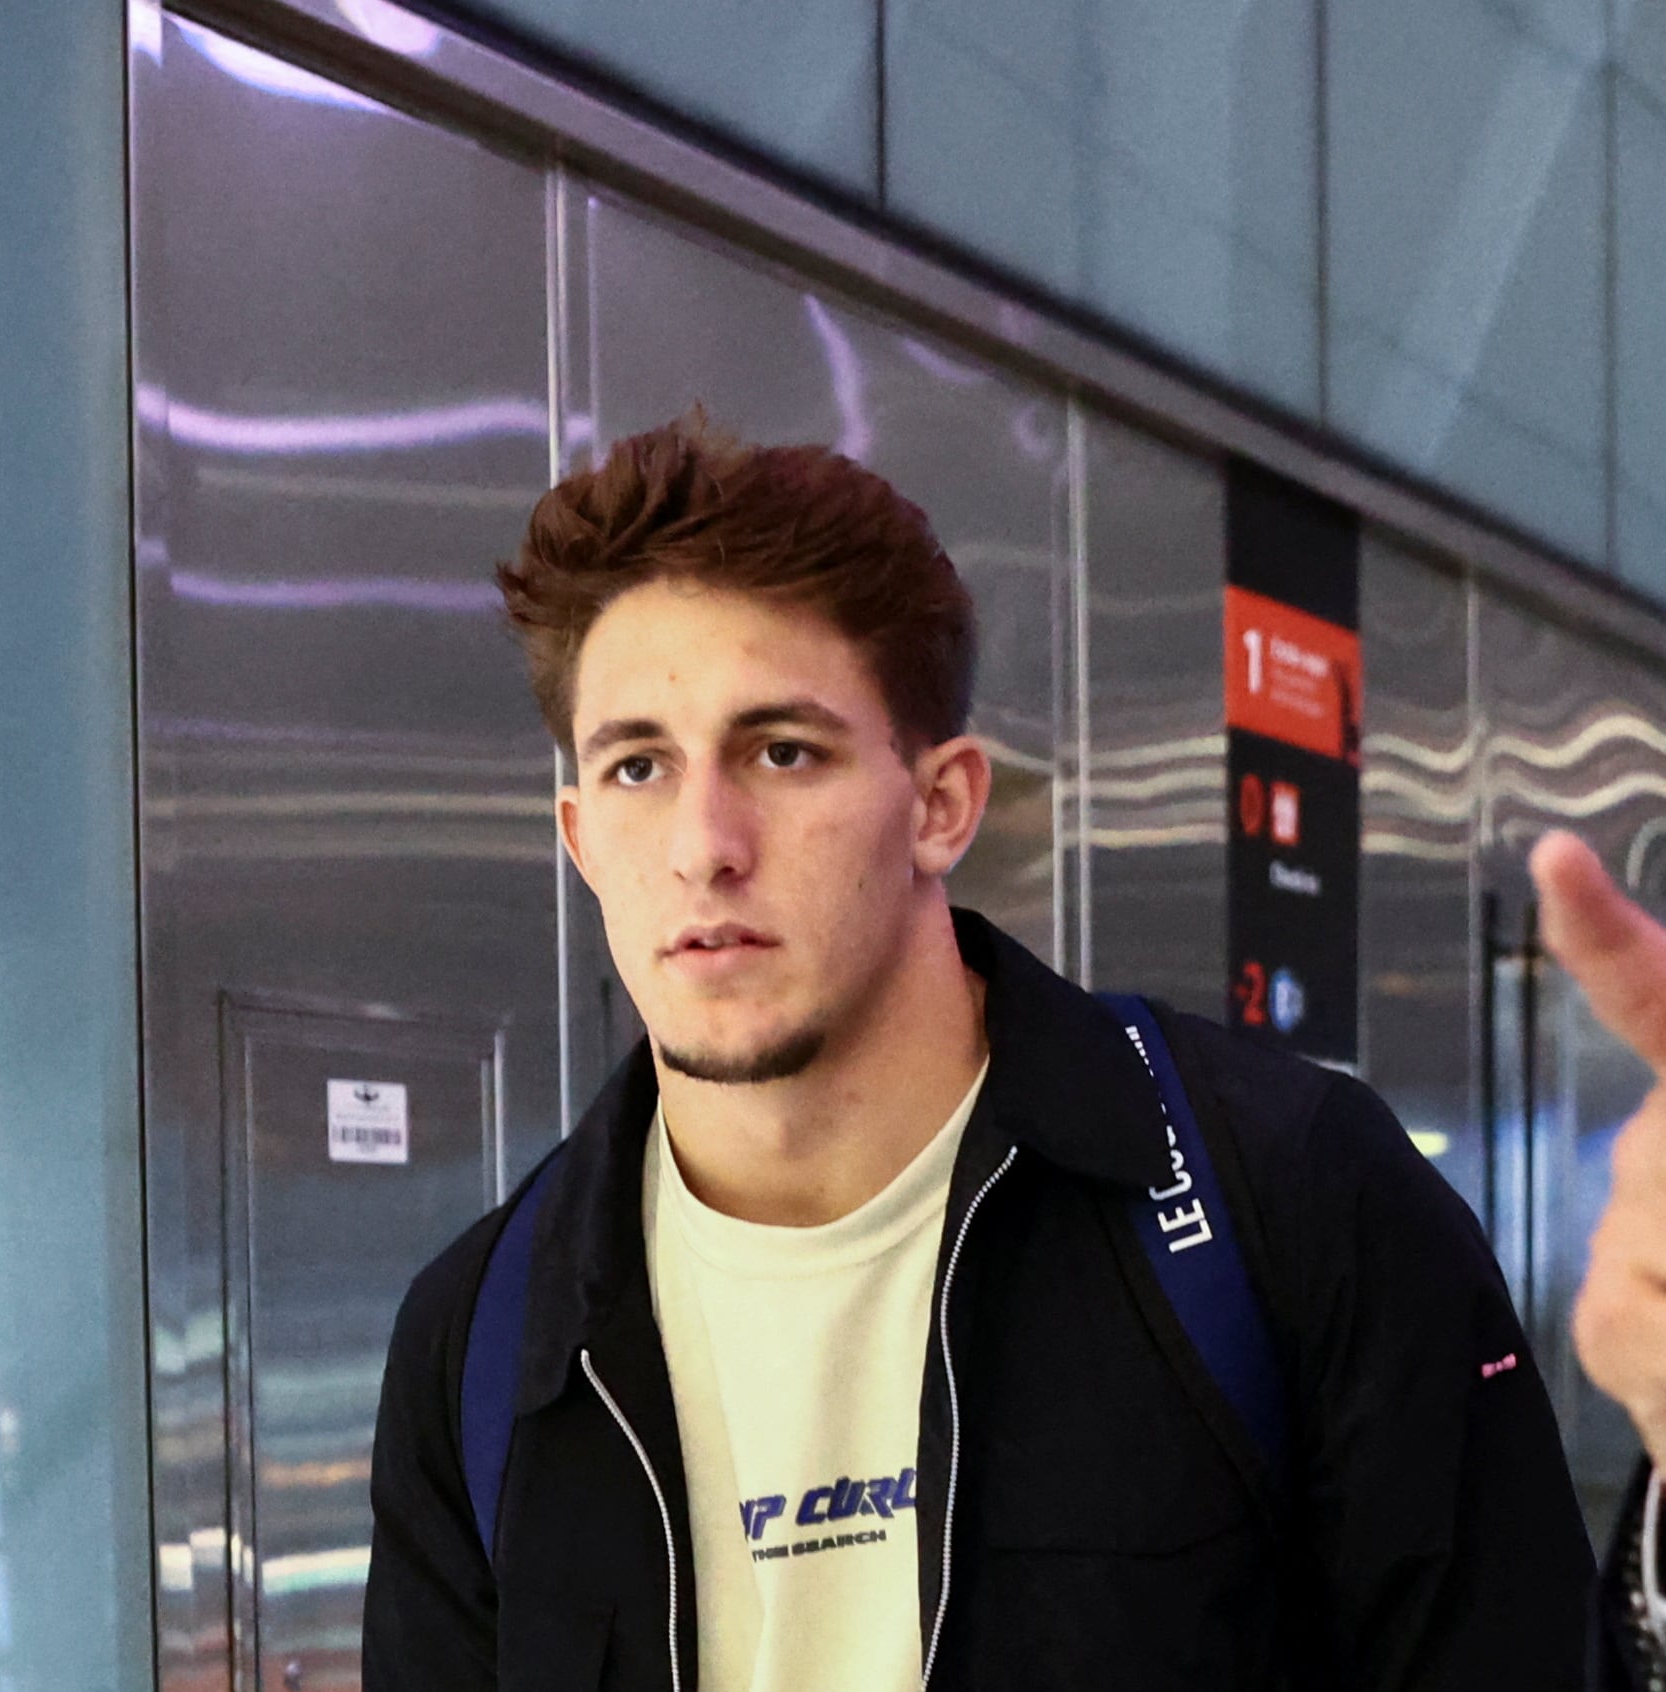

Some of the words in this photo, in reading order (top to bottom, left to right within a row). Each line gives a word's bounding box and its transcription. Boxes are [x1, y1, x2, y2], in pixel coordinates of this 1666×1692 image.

[1243, 629, 1263, 694] 1
[1157, 1198, 1213, 1253] LE
[792, 1529, 887, 1556] SEARCH
